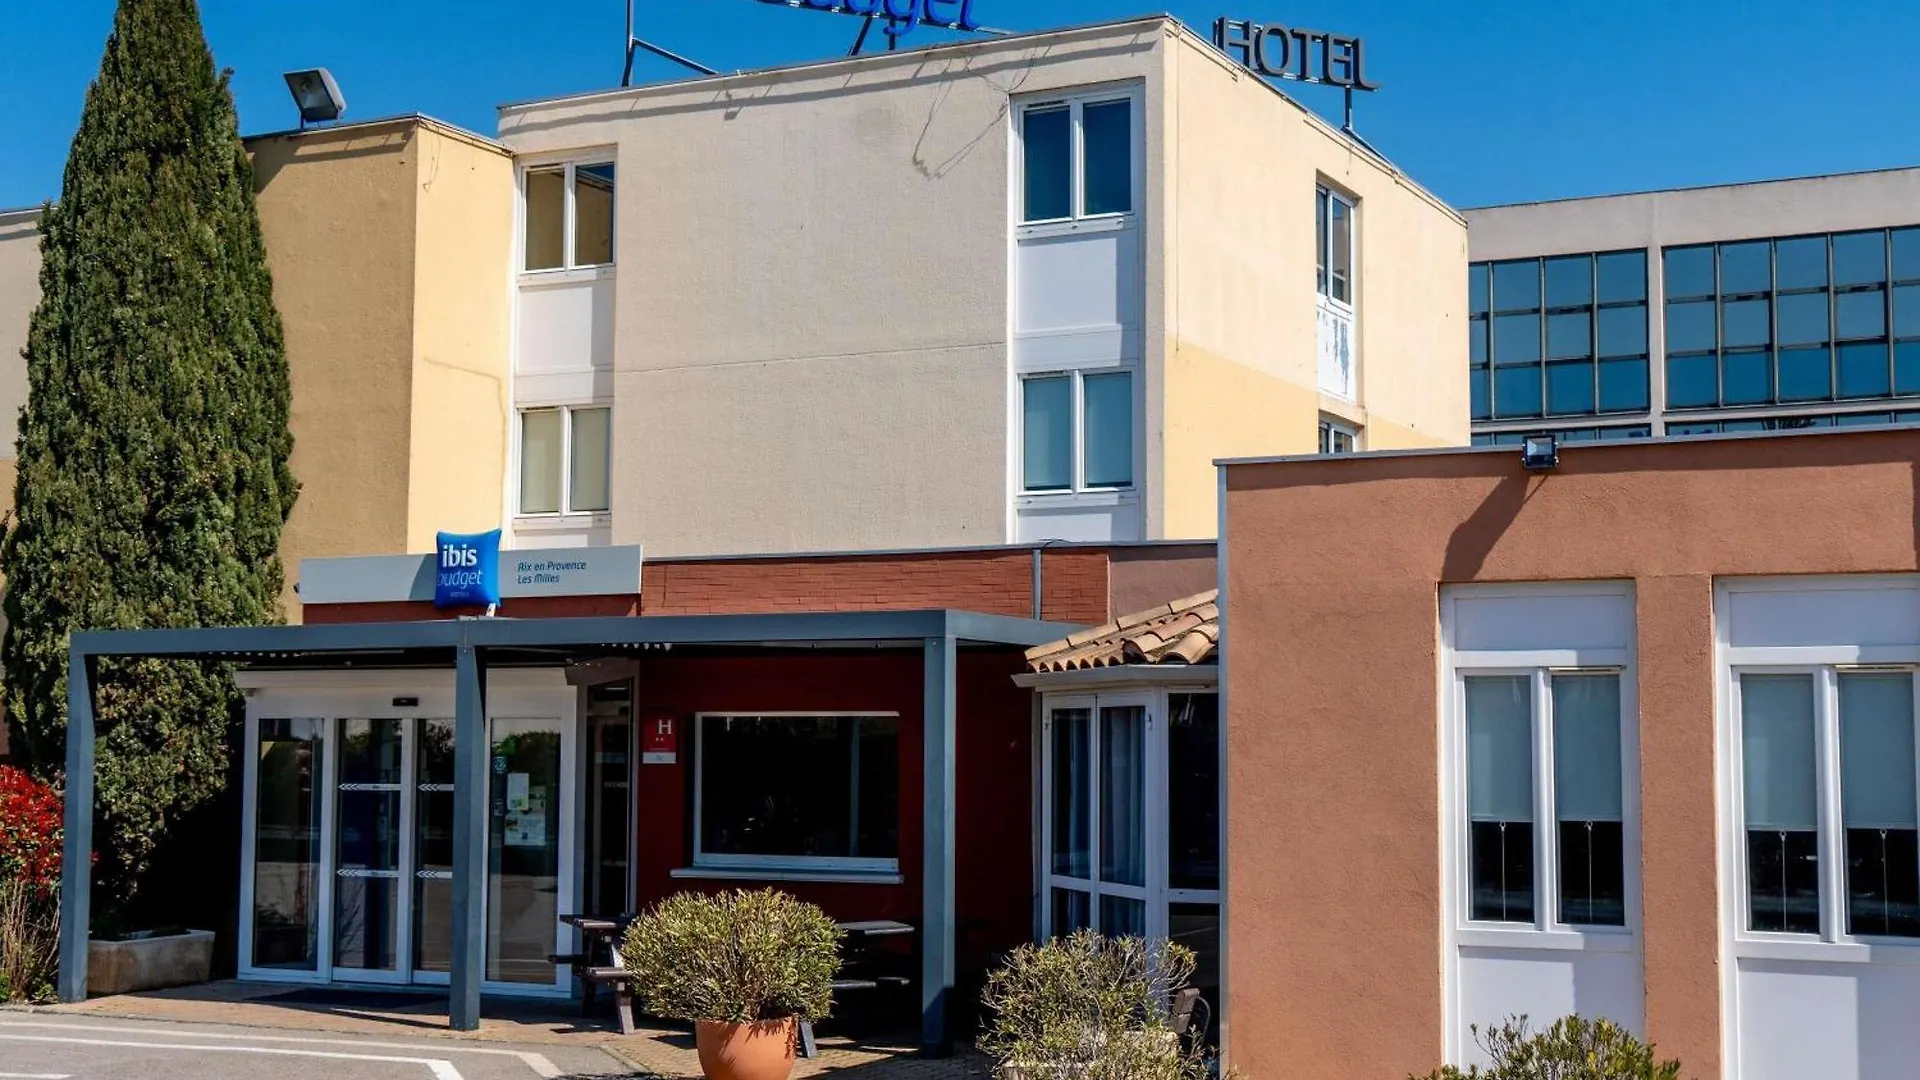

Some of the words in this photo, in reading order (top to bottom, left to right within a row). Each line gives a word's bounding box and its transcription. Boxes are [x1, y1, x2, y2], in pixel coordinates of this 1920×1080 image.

[1214, 17, 1387, 91] HOTEL
[443, 544, 477, 567] ibis
[517, 561, 532, 572] Aix
[534, 563, 545, 571] en
[547, 560, 586, 571] Provence
[517, 575, 532, 584] Les
[534, 573, 560, 583] Milles
[659, 719, 672, 735] H
